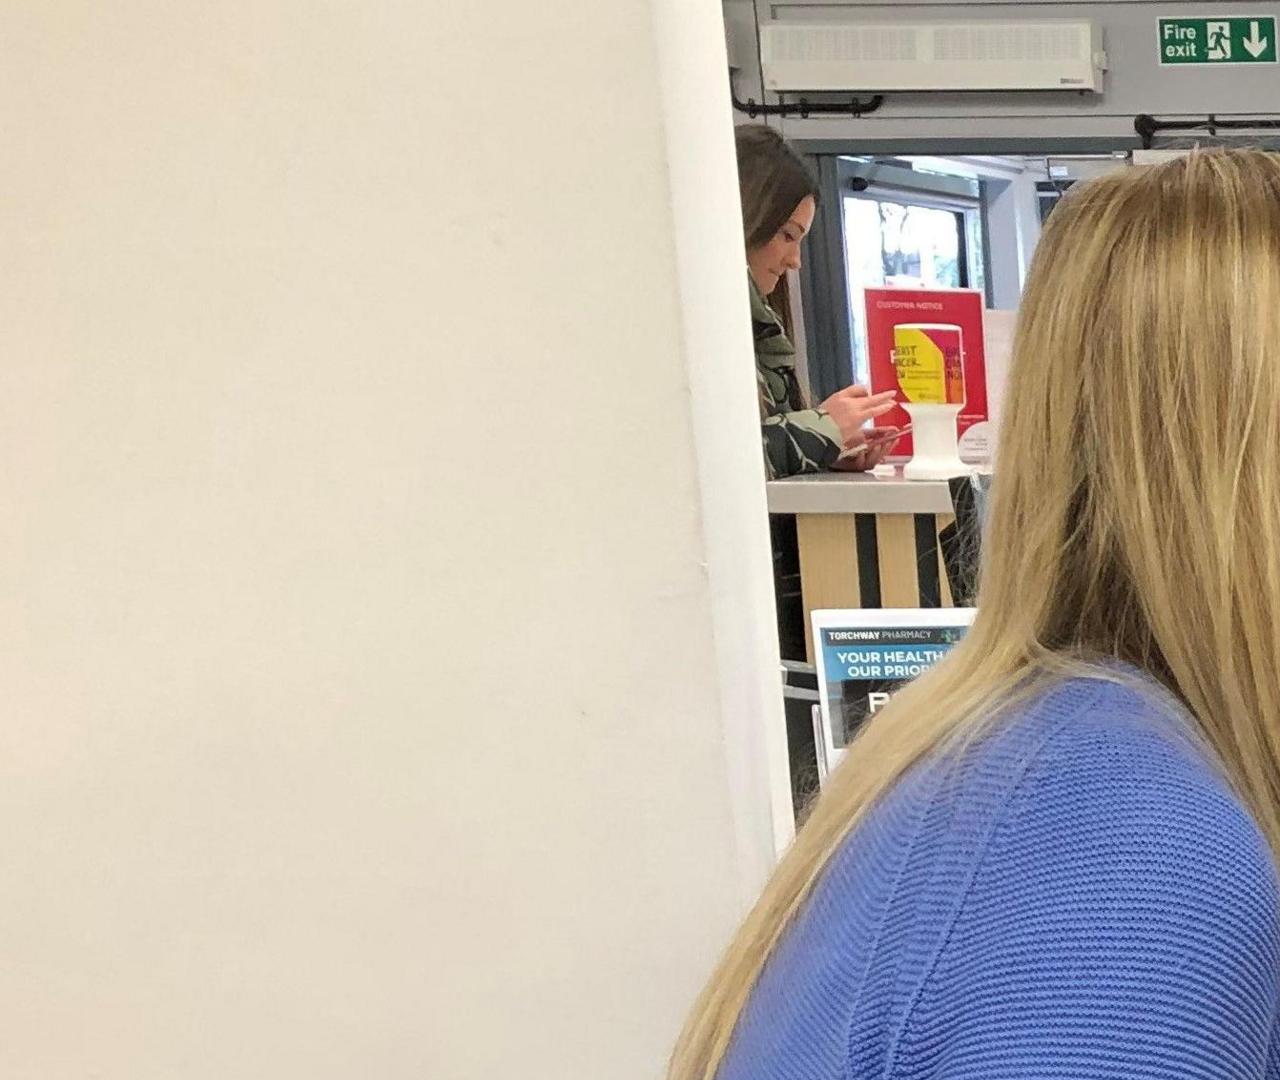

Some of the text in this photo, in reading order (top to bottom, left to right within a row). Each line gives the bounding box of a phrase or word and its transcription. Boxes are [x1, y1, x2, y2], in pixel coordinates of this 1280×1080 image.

[1163, 24, 1197, 40] Fire
[1165, 42, 1197, 57] exit
[828, 630, 932, 640] TORCHWAY PHARMACY
[837, 652, 881, 663] YOUR
[847, 665, 881, 677] OUR
